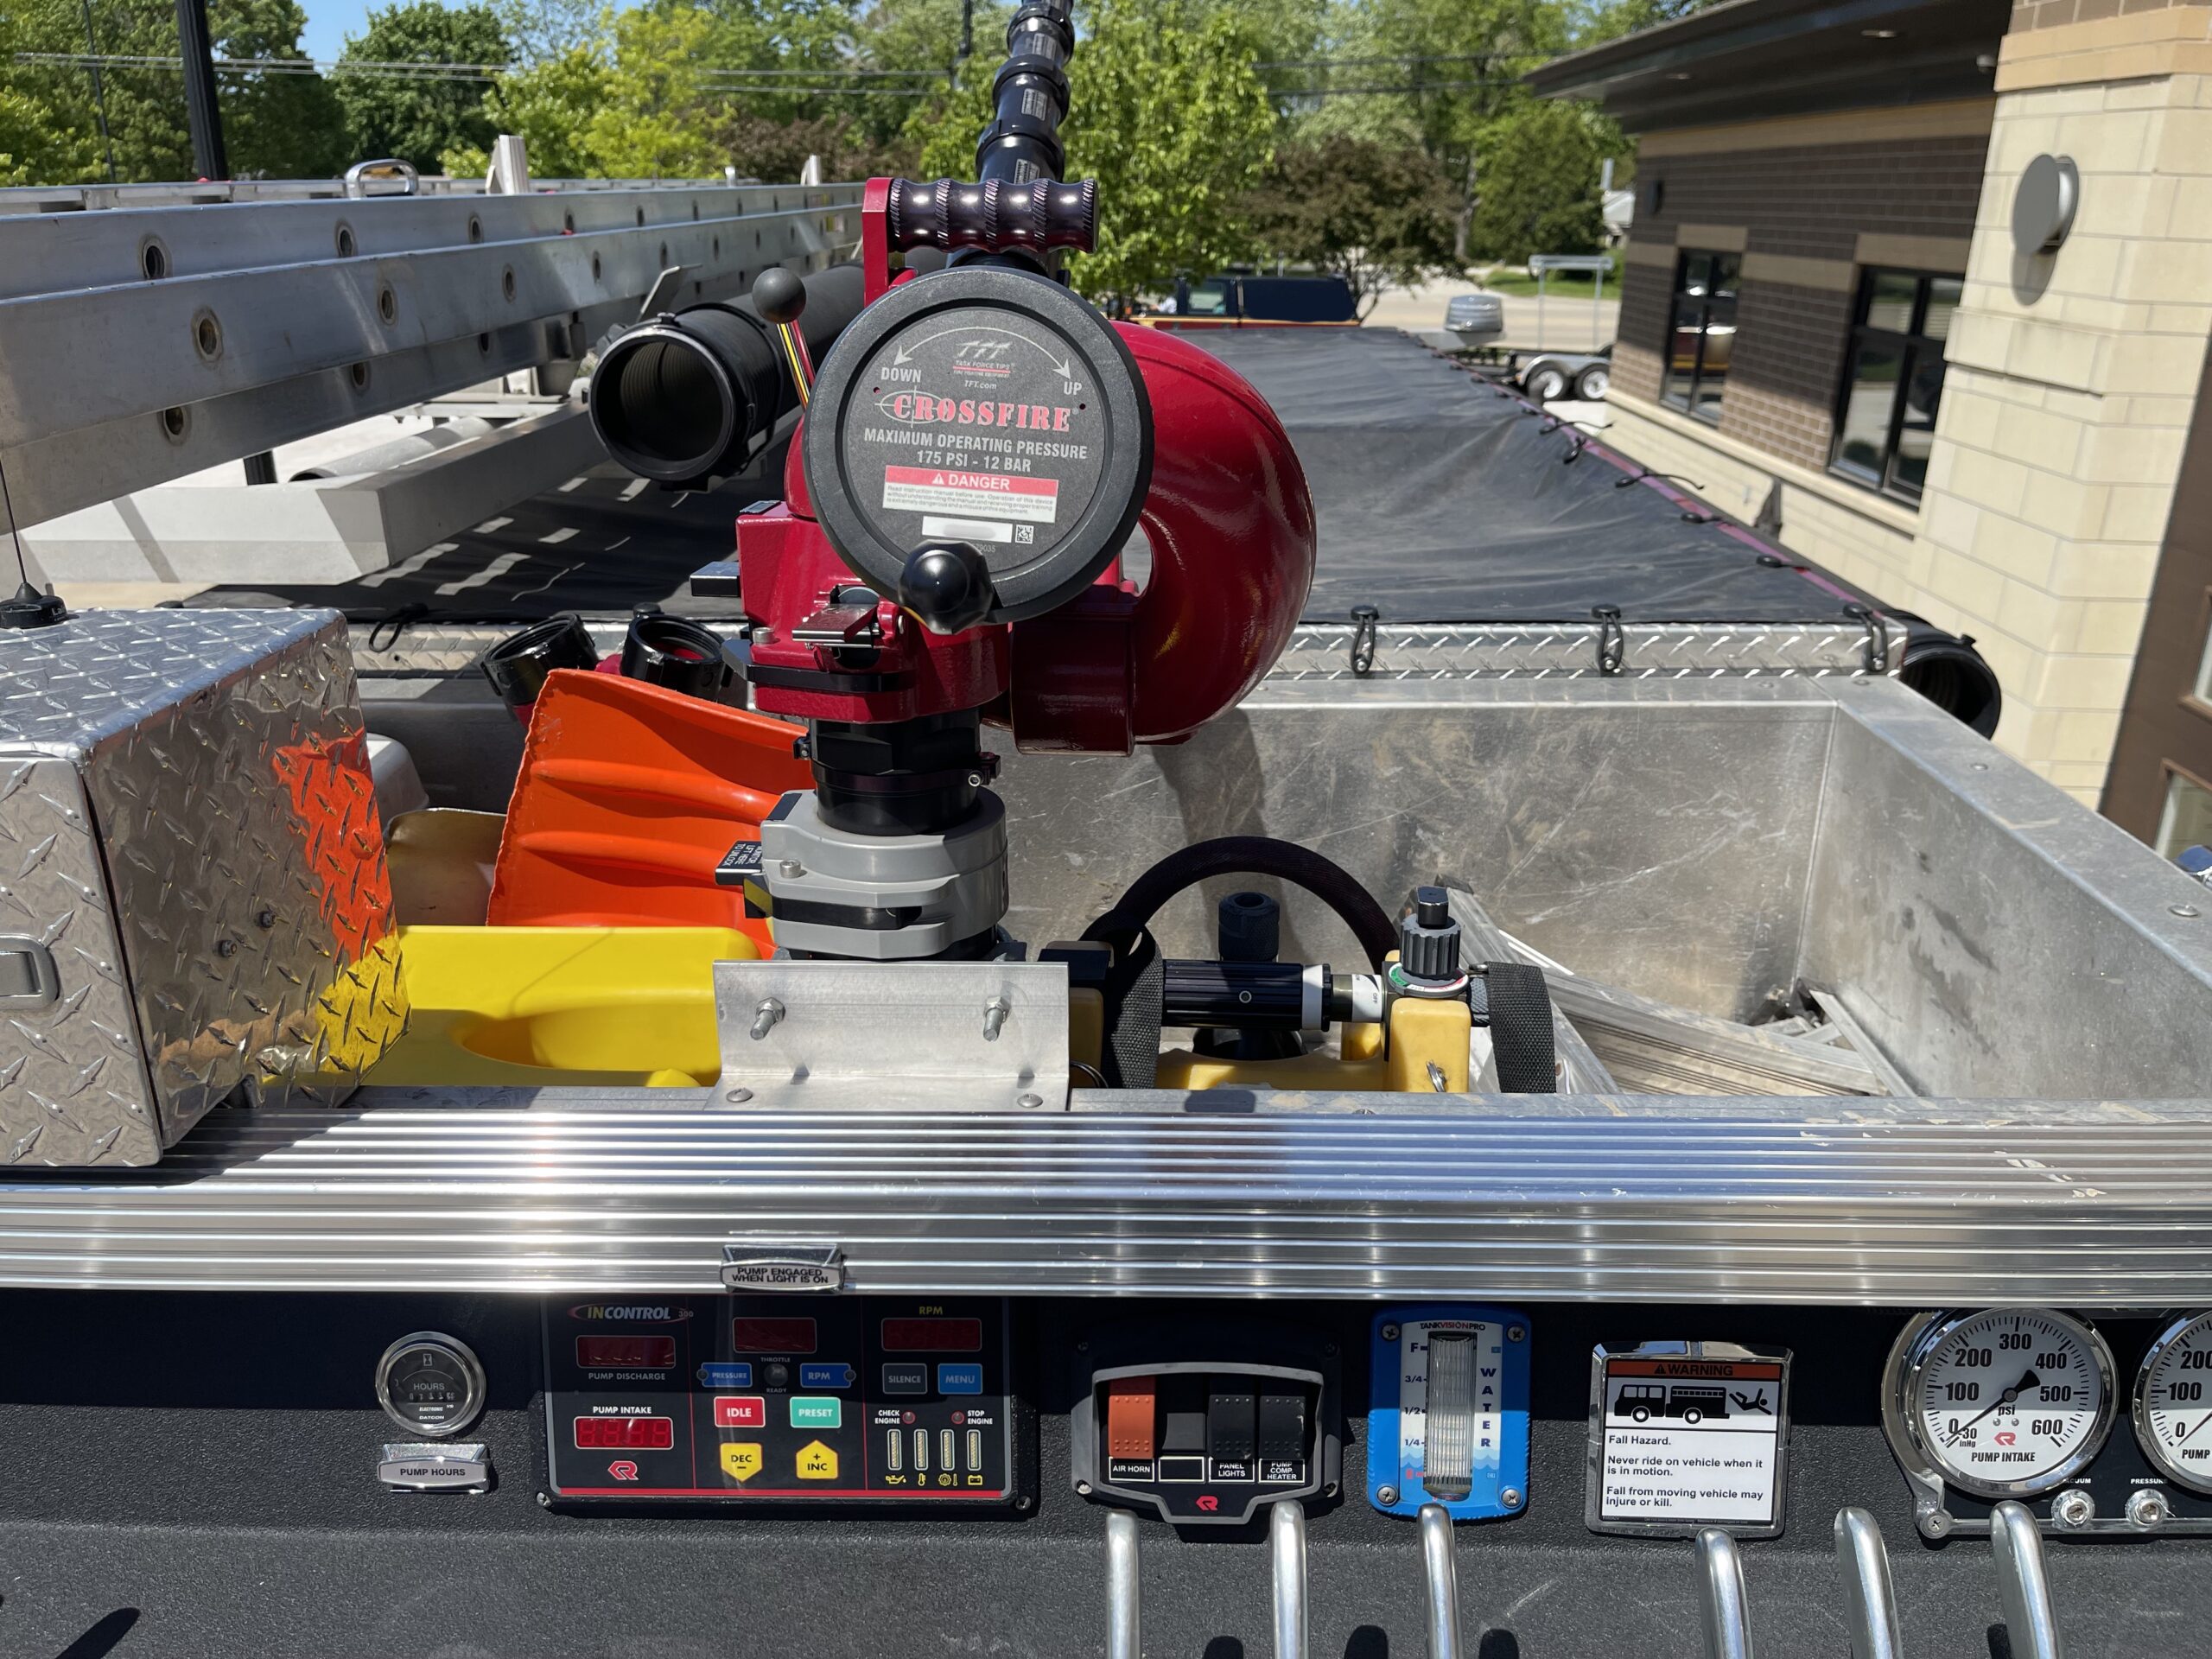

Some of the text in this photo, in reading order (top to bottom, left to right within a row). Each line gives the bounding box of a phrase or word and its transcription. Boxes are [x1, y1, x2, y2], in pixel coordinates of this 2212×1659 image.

[881, 367, 922, 383] DOWN
[964, 380, 997, 389] TFT.com
[1064, 381, 1082, 395] UP
[893, 394, 1070, 432] CROSSFIRE
[864, 428, 1088, 460] MAXIMUM OPERATING PRESSURE
[917, 450, 941, 464] 175
[946, 452, 968, 467] PSI
[983, 455, 1000, 470] 12
[1004, 458, 1032, 473] BAR
[949, 474, 1010, 490] DANGER
[771, 1268, 823, 1276] ENGAGED
[587, 1306, 671, 1319] INCONTROL
[919, 1306, 943, 1315] RPM
[1999, 1334, 2031, 1350] 300
[1955, 1348, 2067, 1370] 200 400
[1668, 1363, 1734, 1376] WARNING
[808, 1372, 830, 1380] RPM
[888, 1375, 921, 1383] SILENCE
[945, 1375, 975, 1384] MENU
[1945, 1382, 2072, 1402] 100 500
[2169, 1382, 2202, 1401] 100
[727, 1408, 752, 1417] IDLE
[798, 1408, 833, 1417] PRESET
[1404, 1407, 1421, 1415] 1/2
[1998, 1405, 2015, 1416] psi
[1948, 1418, 1959, 1434] 0
[2031, 1419, 2063, 1435] 600
[2175, 1422, 2186, 1437] 0
[1405, 1438, 1420, 1447] 1/4
[1609, 1435, 1672, 1446] Fall Hazard.
[731, 1454, 752, 1463] DEC
[1971, 1452, 2036, 1462] PUMP INTAKE
[2182, 1449, 2210, 1459] PUMP
[807, 1463, 828, 1471] INC
[1608, 1455, 1639, 1465] Never
[1642, 1456, 1662, 1466] ride
[1682, 1457, 1720, 1467] vehicle
[1724, 1458, 1753, 1468] when
[1755, 1459, 1763, 1468] it
[1607, 1466, 1673, 1477] is in motion.
[1606, 1486, 1764, 1501] Fall from moving vehicle may
[1606, 1497, 1637, 1507] injure
[1654, 1497, 1673, 1507] kill.
